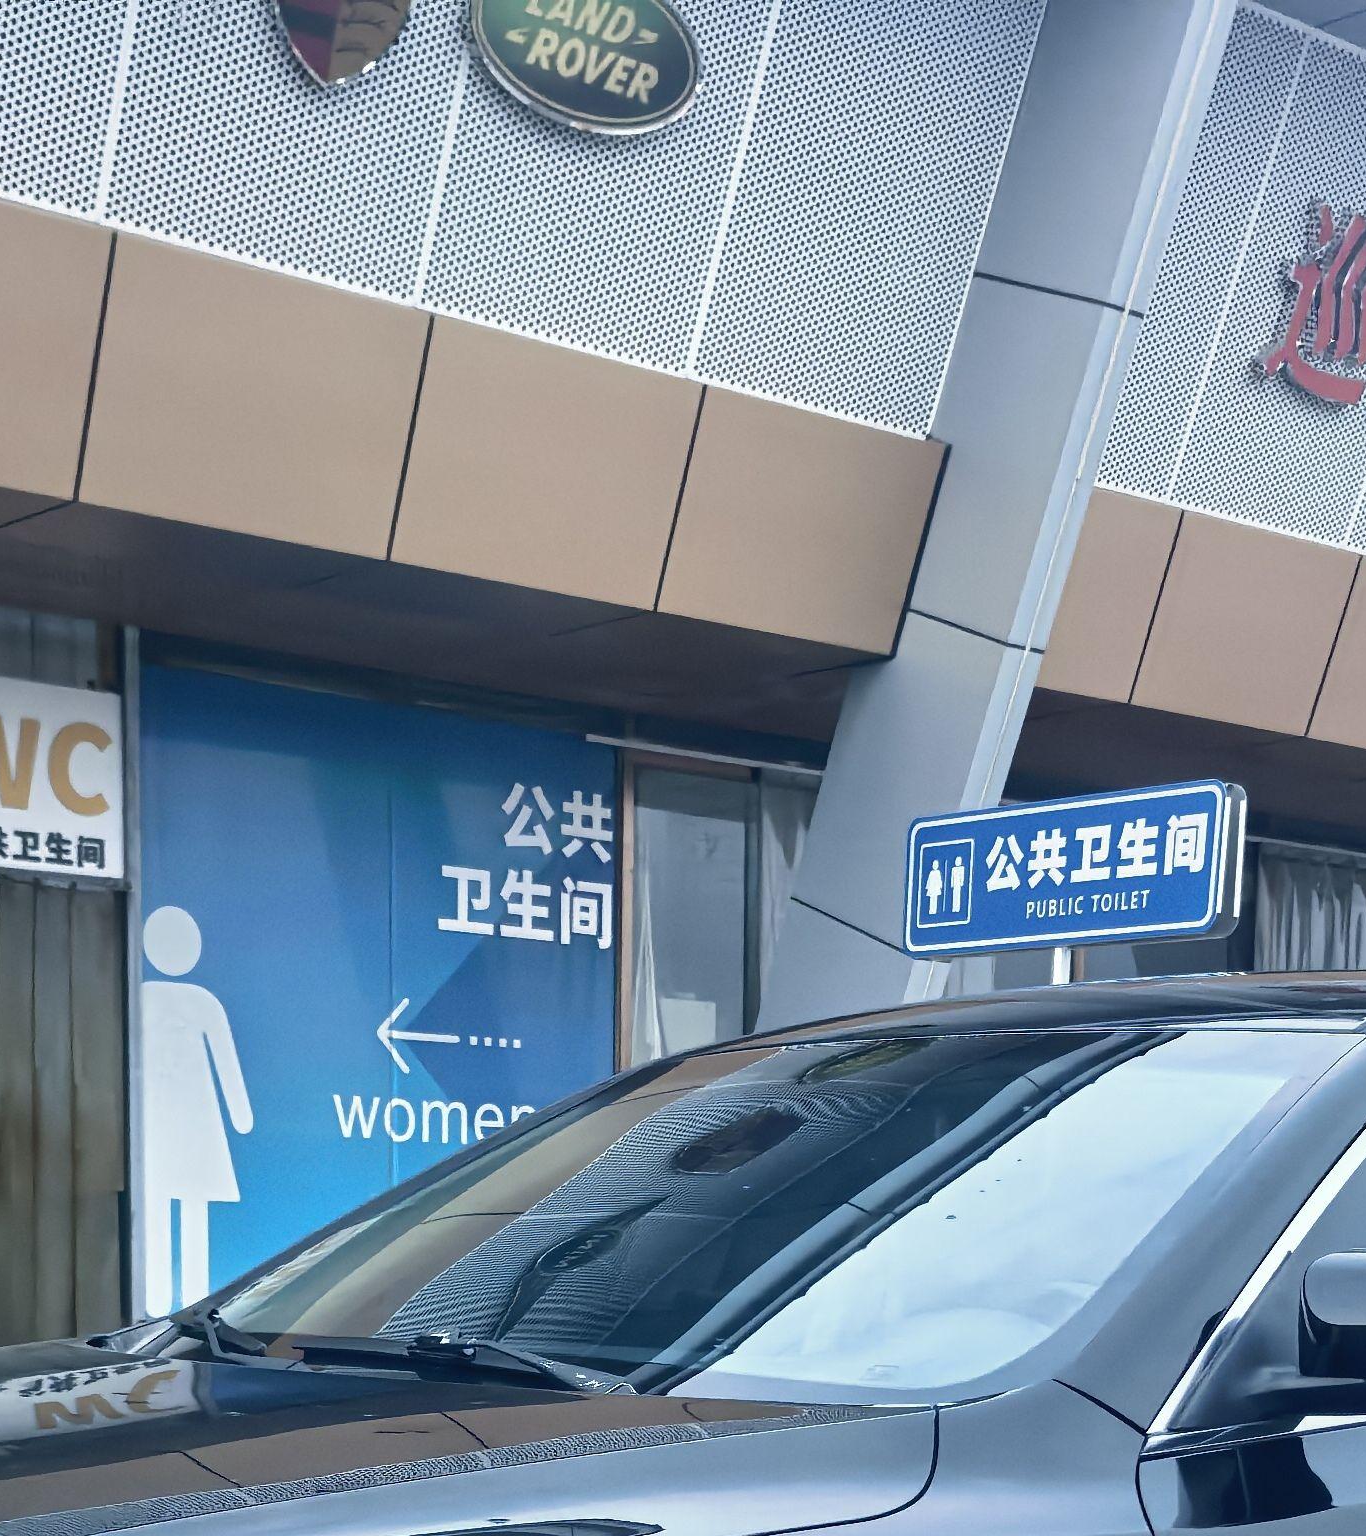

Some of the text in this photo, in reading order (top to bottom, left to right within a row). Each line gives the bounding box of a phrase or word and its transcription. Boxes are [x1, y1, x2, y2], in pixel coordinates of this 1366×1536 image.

[525, 27, 659, 104] ROVER
[501, 782, 613, 864] 公共
[985, 812, 1209, 893] 公共卫生间
[437, 864, 613, 950] 卫生间
[1025, 889, 1151, 919] PUBLIC TOILET
